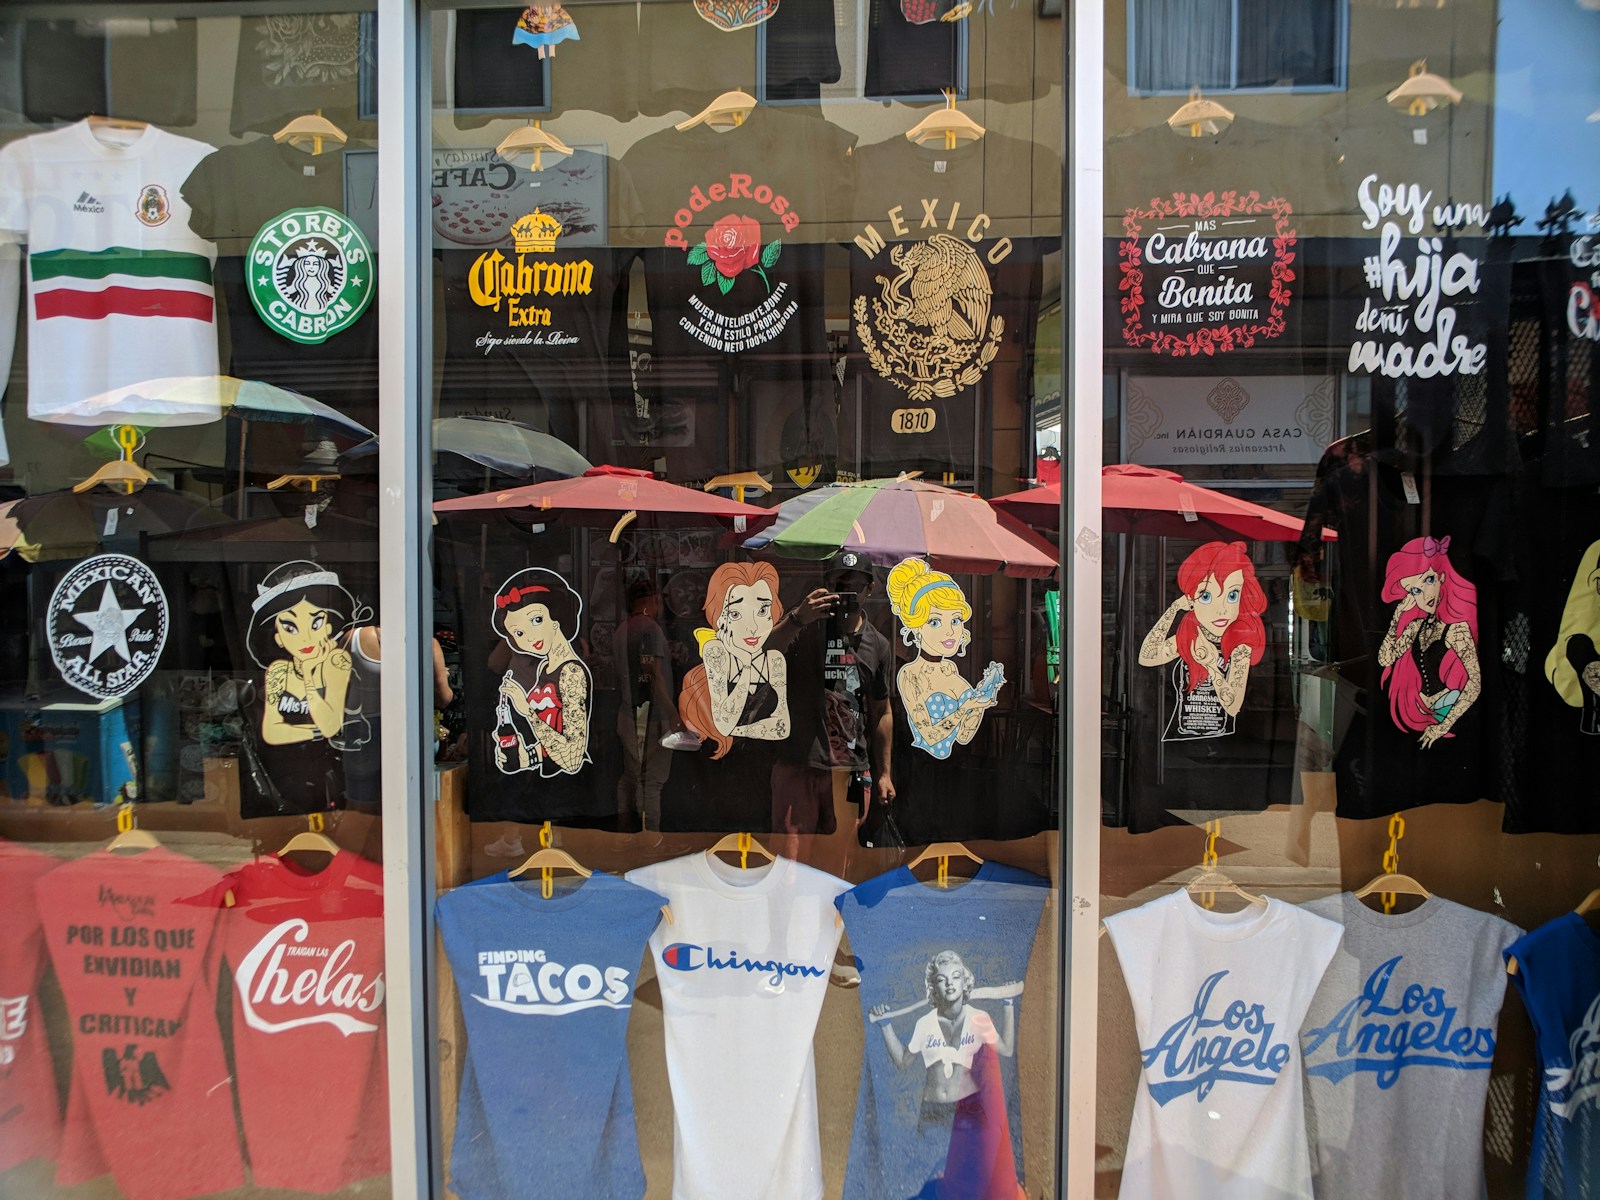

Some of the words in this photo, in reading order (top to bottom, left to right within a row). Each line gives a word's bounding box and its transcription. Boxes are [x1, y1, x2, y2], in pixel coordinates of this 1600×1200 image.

[73, 203, 104, 214] México
[1357, 173, 1433, 234] Soy
[1433, 202, 1491, 227] una
[255, 215, 365, 266] STORBAS
[853, 199, 1013, 265] MEXICO
[1195, 220, 1217, 231] MAS
[1145, 231, 1268, 264] Cabrona
[468, 248, 594, 312] Cabrona
[1197, 264, 1215, 275] QUE
[688, 294, 714, 320] MUJER
[1158, 275, 1253, 308] Bonita
[268, 297, 353, 334] CABRON
[508, 297, 551, 327] Extra
[698, 316, 706, 327] Y
[704, 321, 722, 338] CON
[724, 326, 752, 341] ESTILO
[753, 309, 781, 333] PROPIO
[1152, 314, 1158, 323] Y
[1161, 313, 1182, 324] MIRA
[1186, 312, 1203, 323] QUE
[1208, 311, 1226, 322] SOY
[1229, 309, 1259, 320] BONITA
[475, 331, 502, 355] Sigo
[503, 331, 533, 345] siendo
[679, 317, 723, 351] CONTENIDO
[724, 340, 744, 353] NETO
[1348, 307, 1487, 379] madre
[899, 412, 929, 429] 1810
[60, 566, 156, 612] MEXICAN
[128, 628, 154, 642] Pride
[66, 655, 103, 686] ALL
[106, 650, 150, 688] STAR
[1184, 705, 1222, 714] WHISKEY
[67, 925, 103, 946] POR
[110, 926, 149, 947] LOS
[154, 928, 195, 951] QUE
[287, 946, 315, 957] TRAIGAN
[316, 947, 329, 957] LAS
[83, 954, 180, 979] ENVIDIAN
[478, 950, 547, 965] FINDING
[662, 942, 826, 986] Chingon
[235, 918, 386, 1037] Chelas
[479, 962, 630, 1003] TACOS
[1362, 956, 1445, 1017] Los
[124, 987, 136, 1006] Y
[1192, 970, 1265, 1036] Los
[1303, 994, 1496, 1090] Angeles
